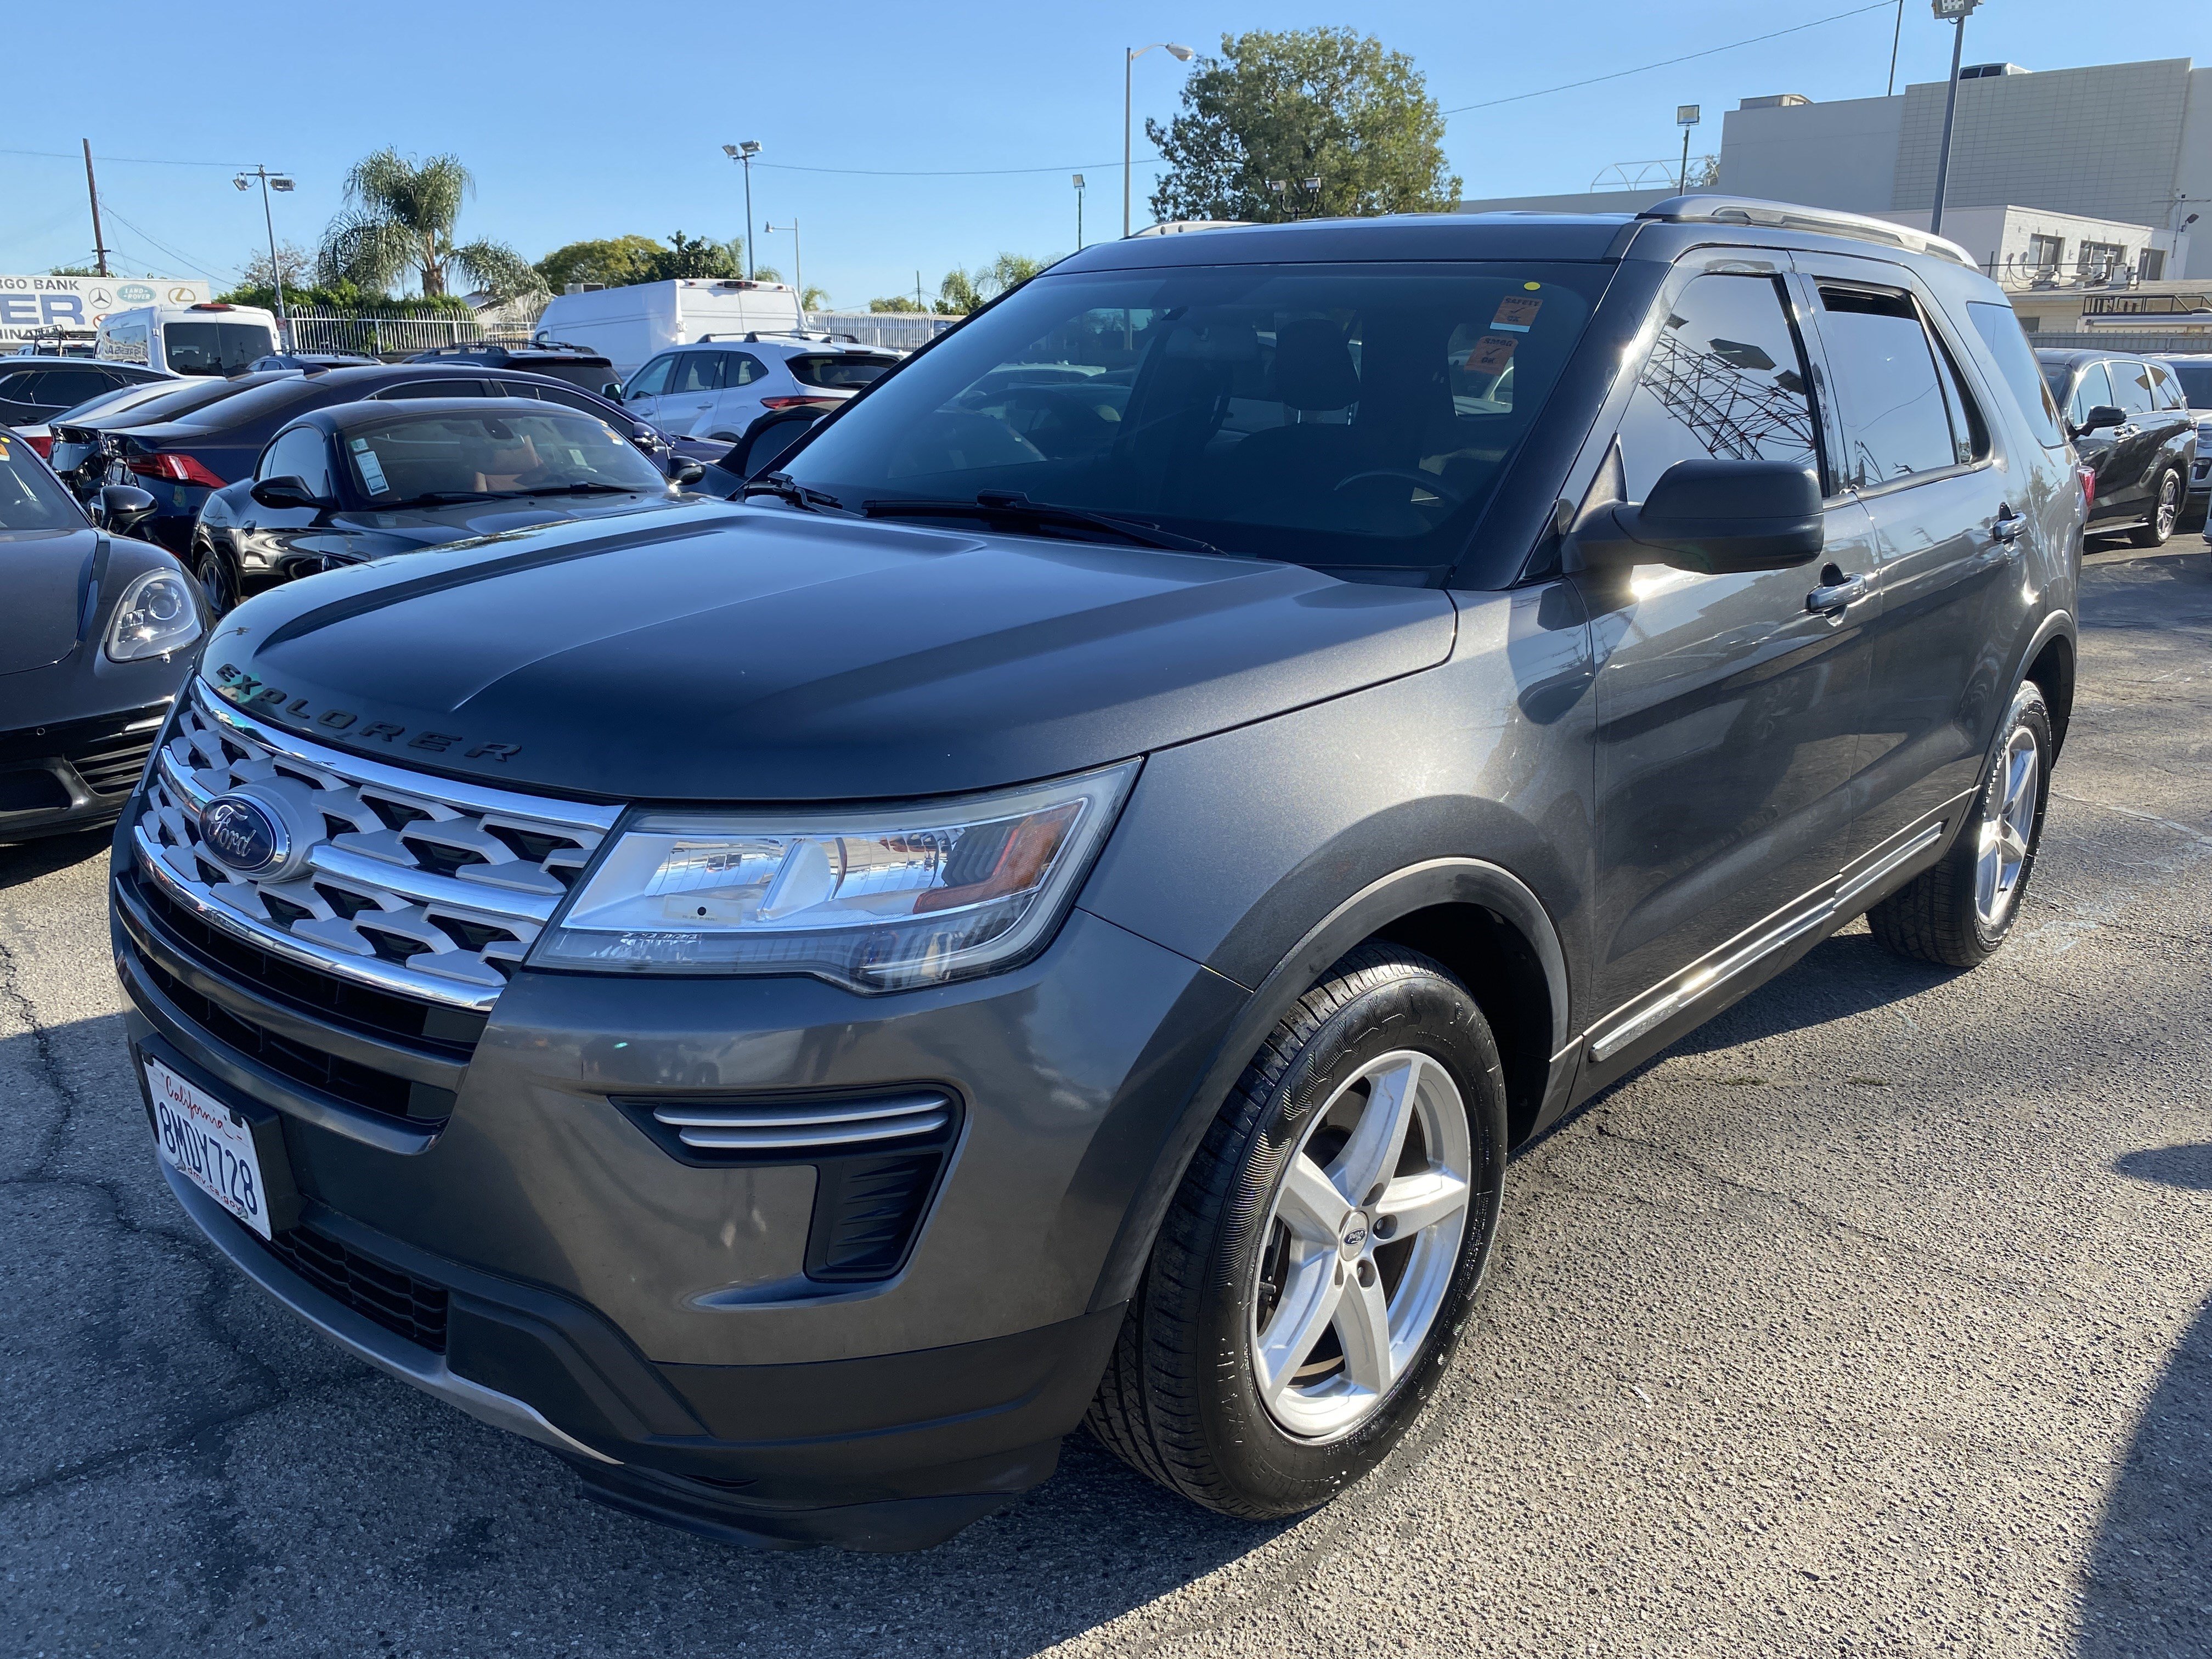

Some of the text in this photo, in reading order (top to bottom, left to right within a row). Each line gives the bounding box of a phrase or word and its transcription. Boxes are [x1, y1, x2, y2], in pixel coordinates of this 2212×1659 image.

[33, 279, 80, 290] BANK
[1483, 338, 1513, 347] SMOG
[216, 663, 522, 762] EXPLORER
[208, 804, 257, 857] Ford
[166, 1075, 233, 1139] California
[159, 1101, 258, 1215] 8MDY728
[188, 1167, 242, 1212] dmv.ca.gov
[1347, 1230, 1364, 1244] Ford
